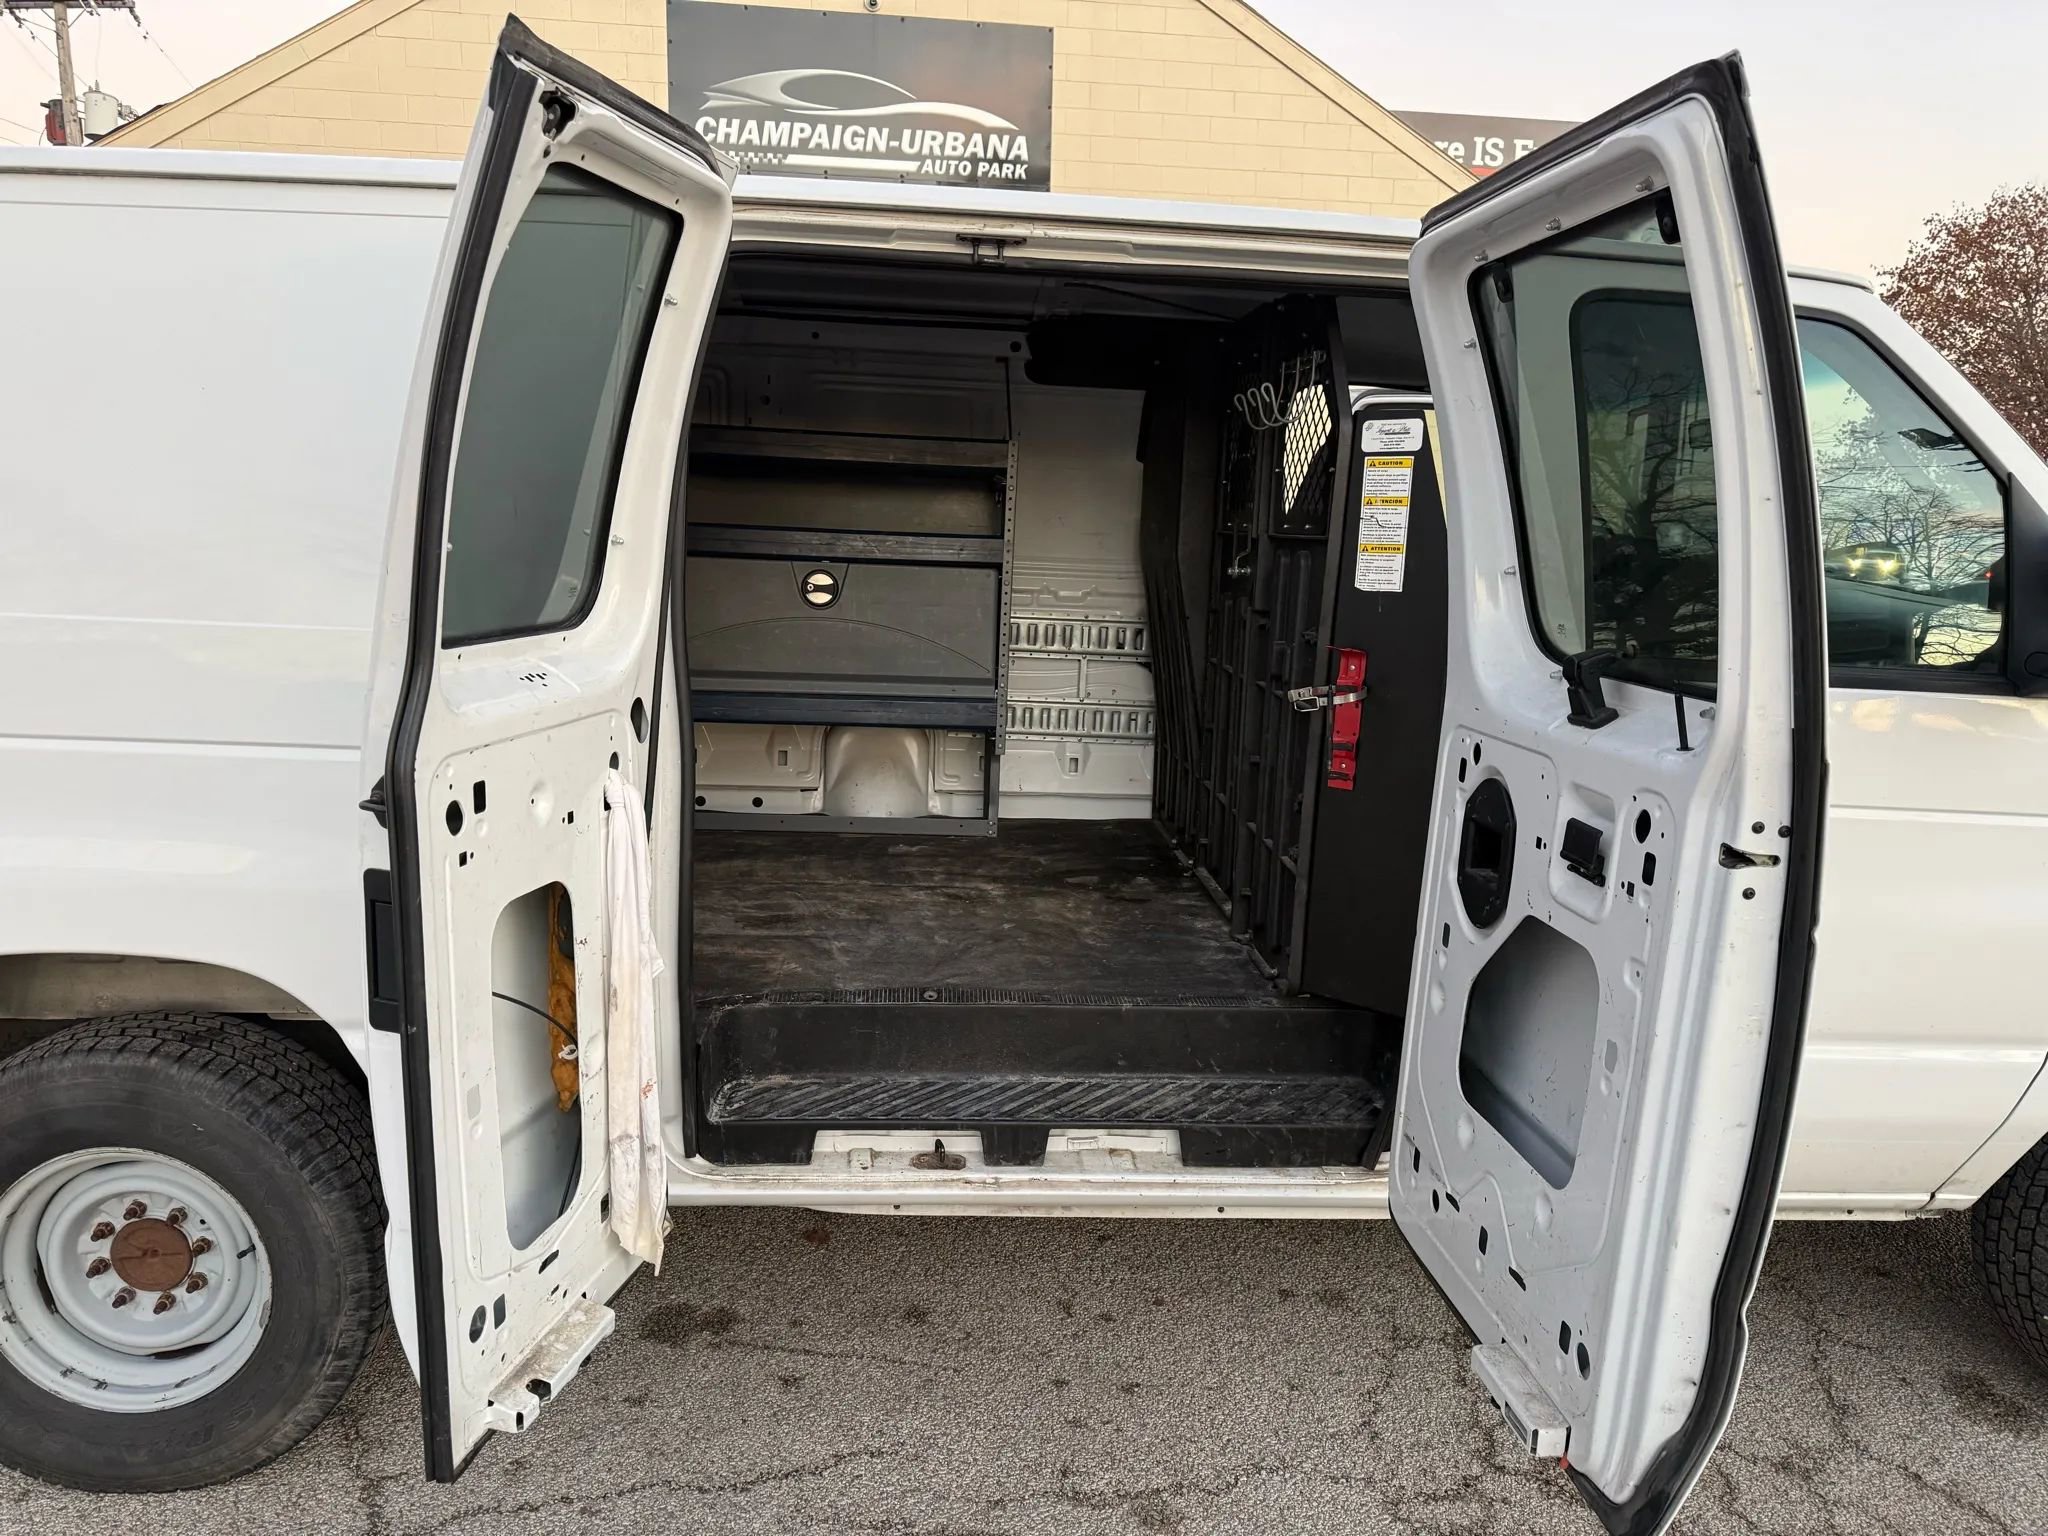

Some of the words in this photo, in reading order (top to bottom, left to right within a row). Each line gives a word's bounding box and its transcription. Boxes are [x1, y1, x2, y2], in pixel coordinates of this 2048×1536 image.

[695, 116, 1028, 161] CHAMPAIGN-URBANA
[1472, 136, 1505, 167] IS
[921, 158, 972, 176] AUTO
[977, 161, 1028, 180] PARK
